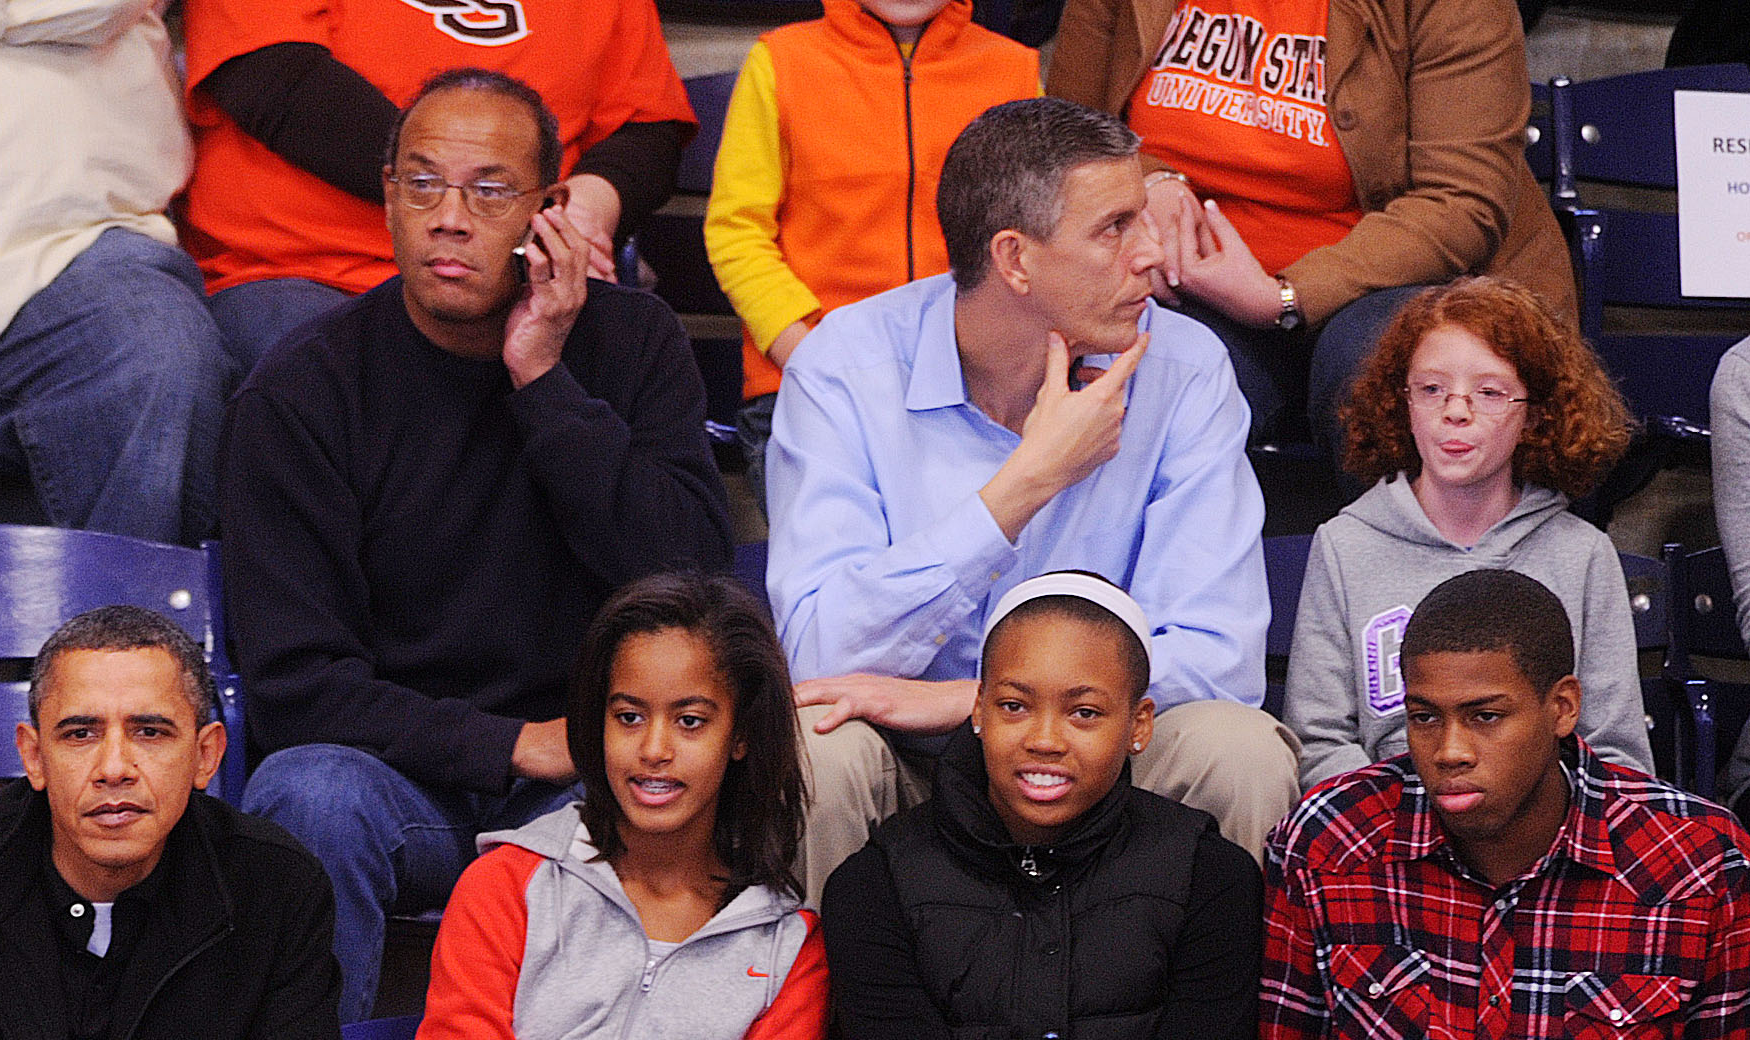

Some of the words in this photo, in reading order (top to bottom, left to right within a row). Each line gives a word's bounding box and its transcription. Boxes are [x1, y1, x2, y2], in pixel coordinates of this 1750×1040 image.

[1260, 33, 1327, 106] STA
[1146, 72, 1327, 147] UNIVERSITY
[1713, 138, 1750, 154] RES
[1728, 182, 1750, 195] HO
